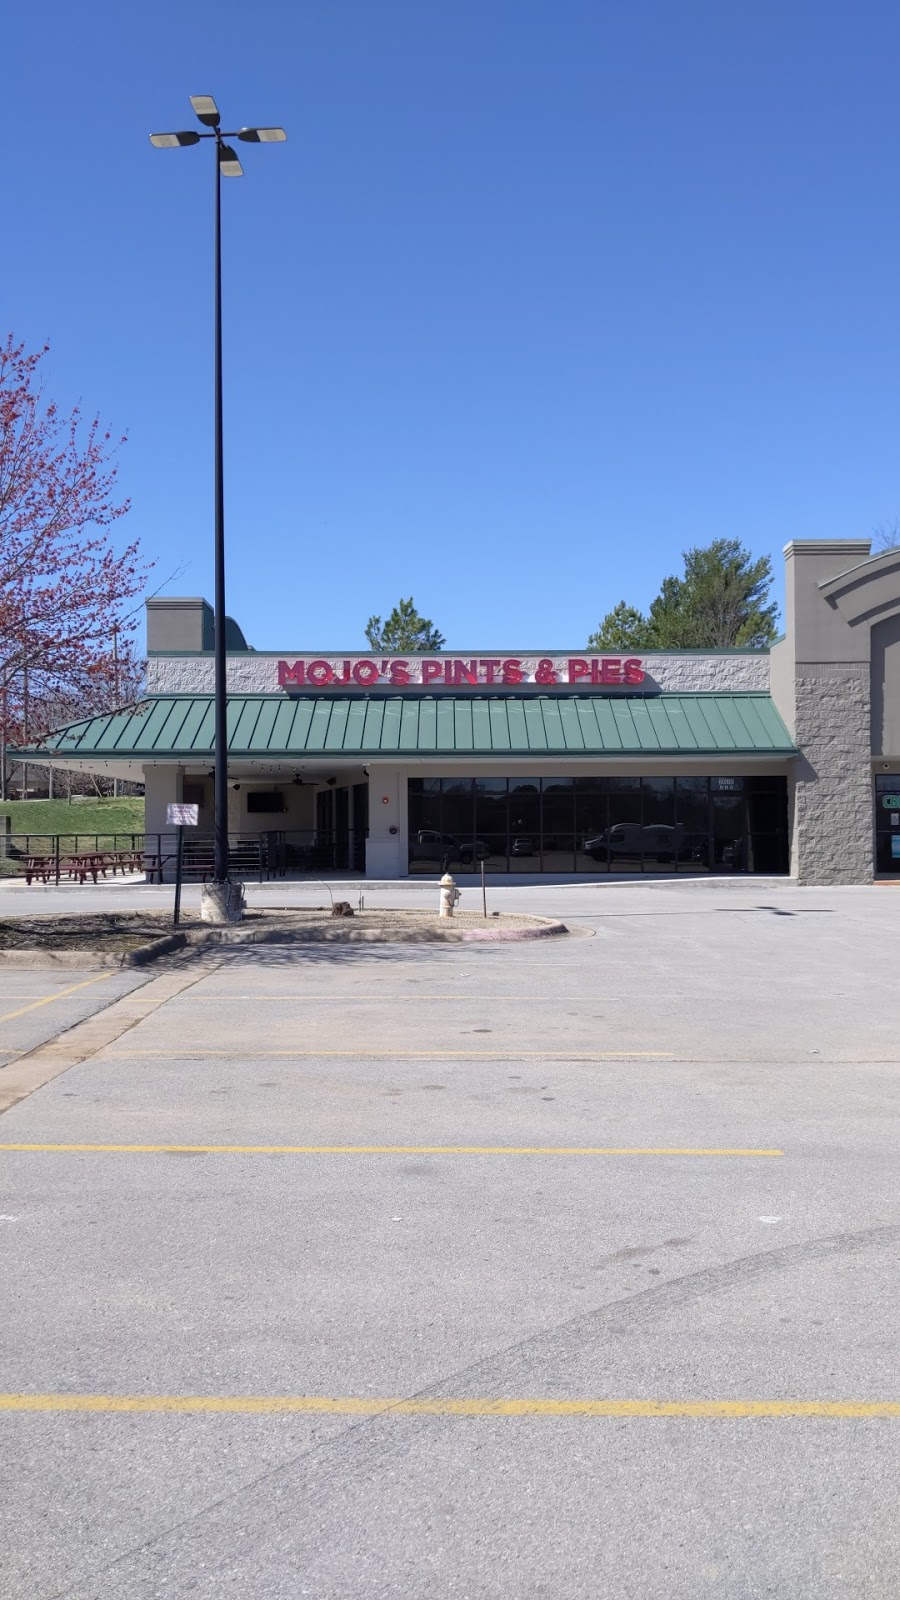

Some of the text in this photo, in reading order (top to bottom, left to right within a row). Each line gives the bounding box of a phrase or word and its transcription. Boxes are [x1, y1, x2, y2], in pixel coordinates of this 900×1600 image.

[278, 659, 645, 686] MOJO'S PINTS & PIES
